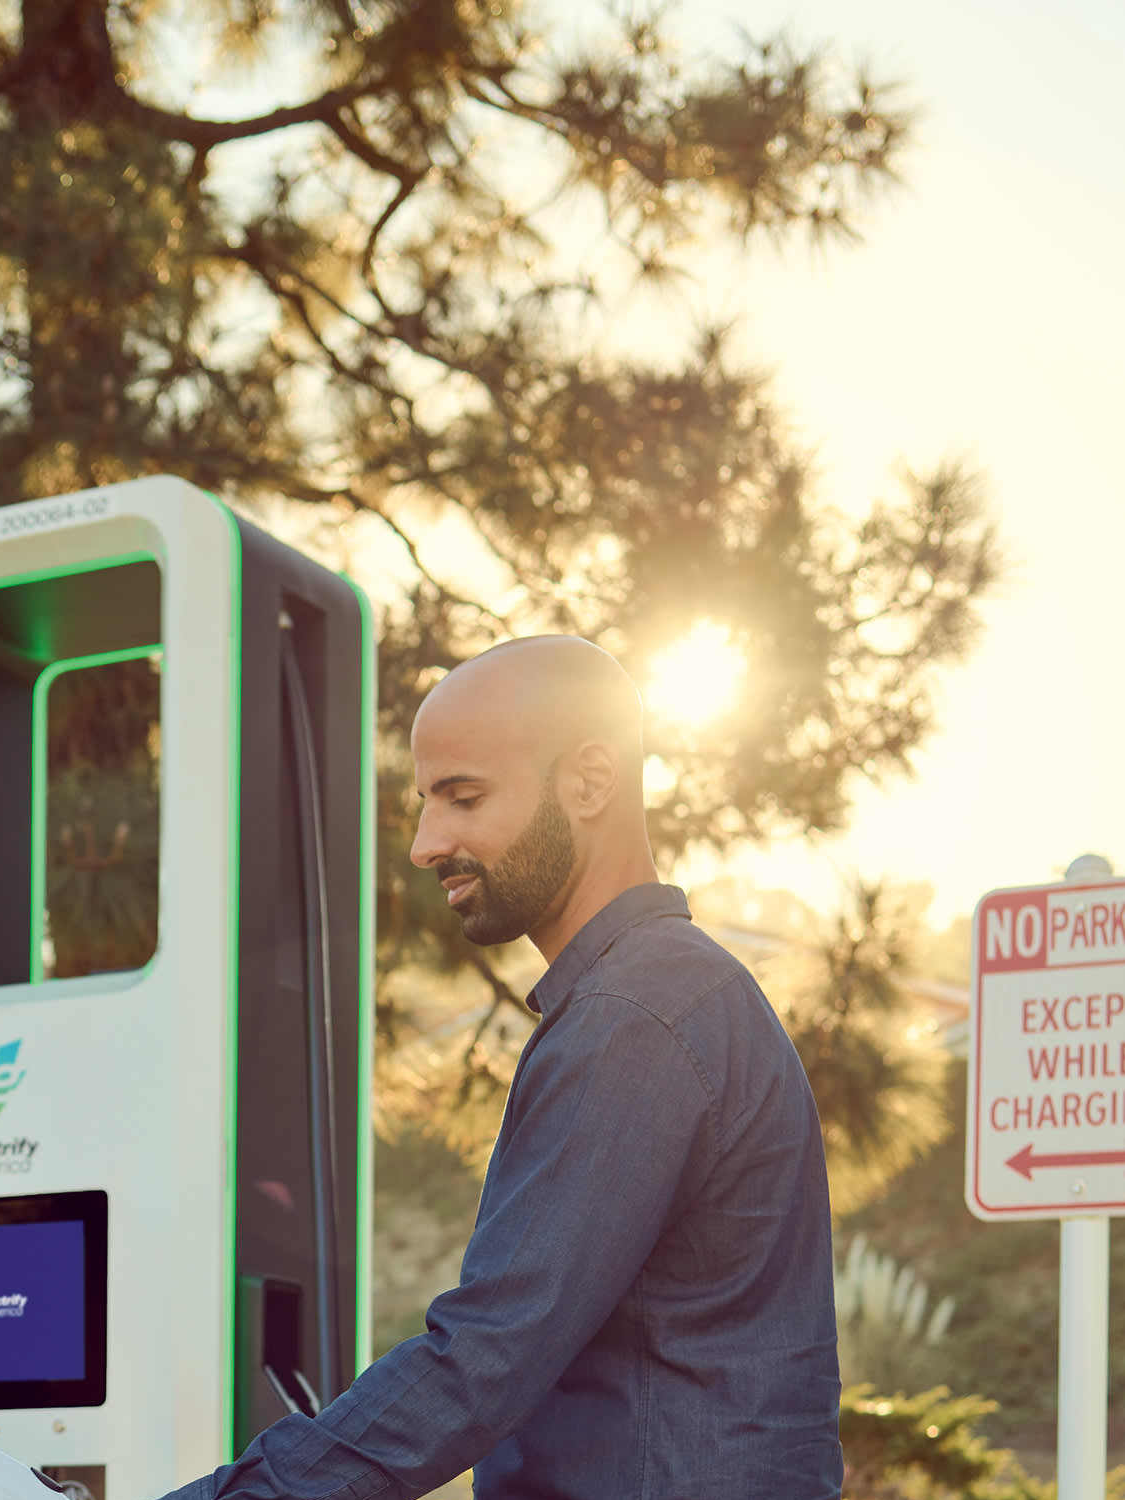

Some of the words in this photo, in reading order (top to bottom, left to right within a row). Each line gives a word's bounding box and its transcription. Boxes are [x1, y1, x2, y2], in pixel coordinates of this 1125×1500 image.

[985, 905, 1044, 960] NO
[1050, 902, 1125, 951] PARK
[1022, 992, 1125, 1034] EXCEP
[989, 1090, 1125, 1132] CHARGI
